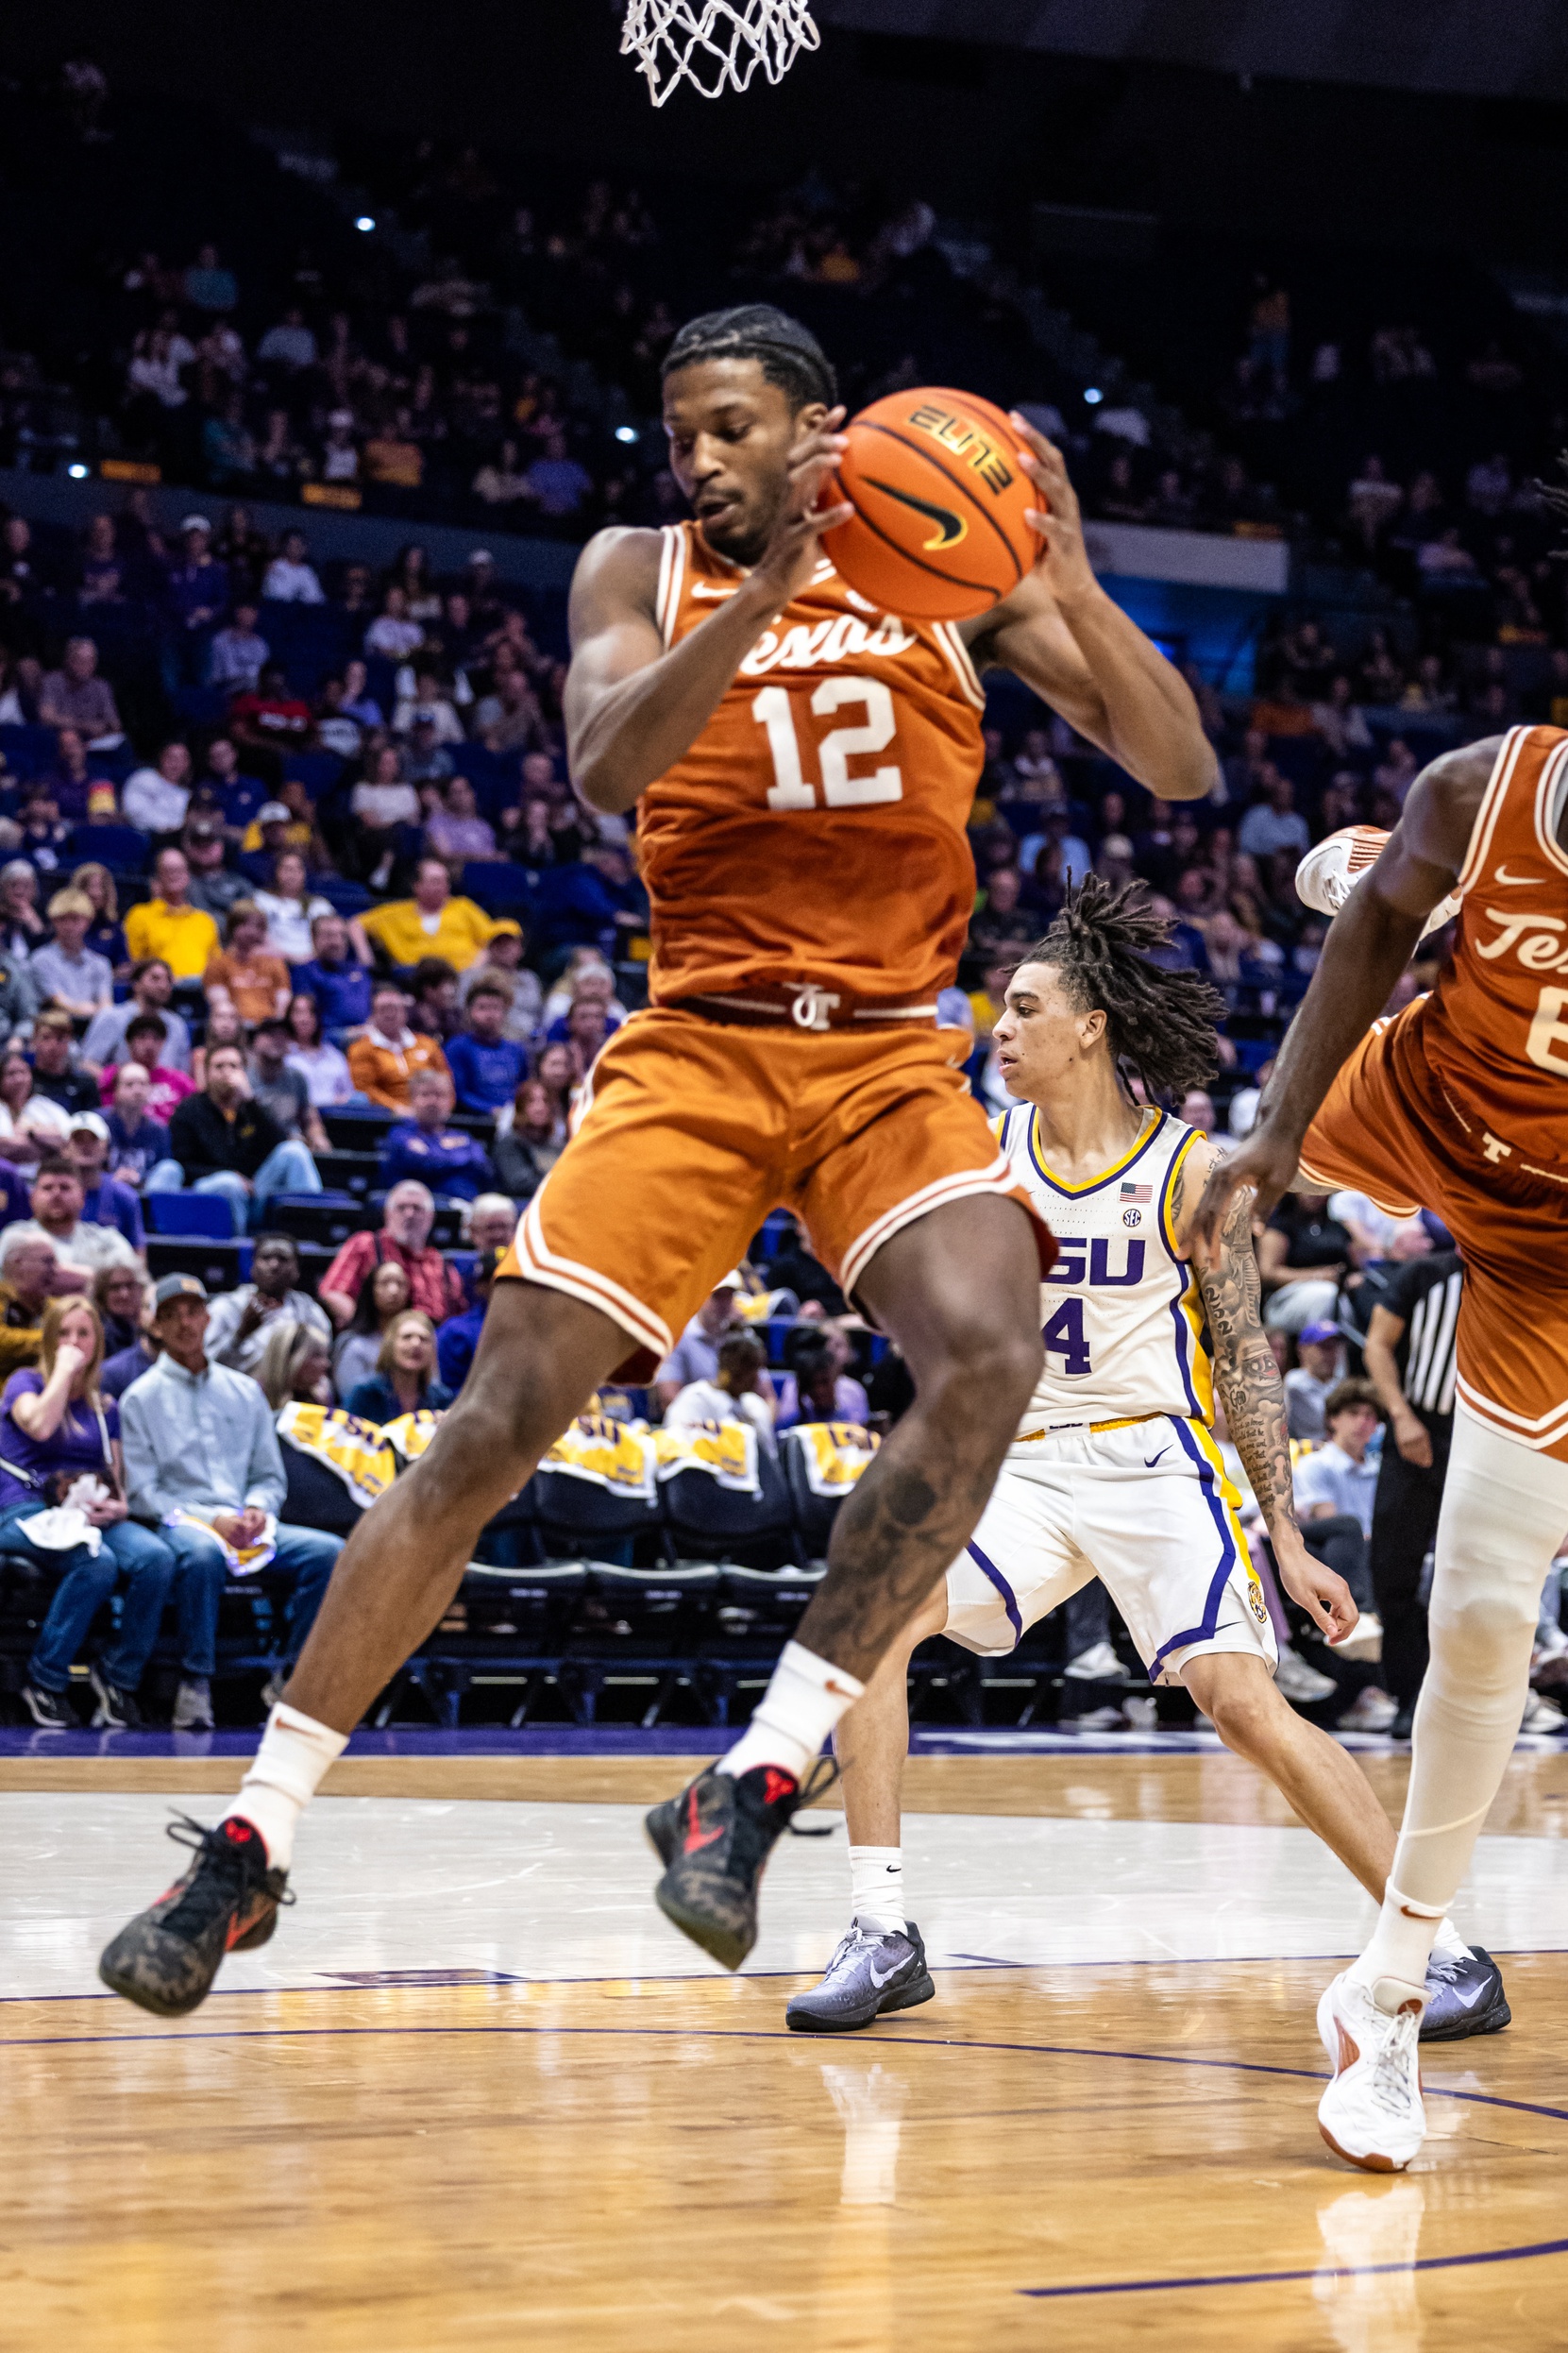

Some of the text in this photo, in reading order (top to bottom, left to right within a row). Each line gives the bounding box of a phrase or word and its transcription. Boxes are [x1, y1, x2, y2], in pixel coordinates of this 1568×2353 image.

[909, 404, 1013, 497] ELITE
[740, 614, 919, 675] exas
[752, 676, 902, 811] 12
[1481, 1133, 1511, 1163] T
[1123, 1209, 1141, 1227] SEC
[1041, 1236, 1145, 1286] SU
[1043, 1297, 1092, 1375] 4
